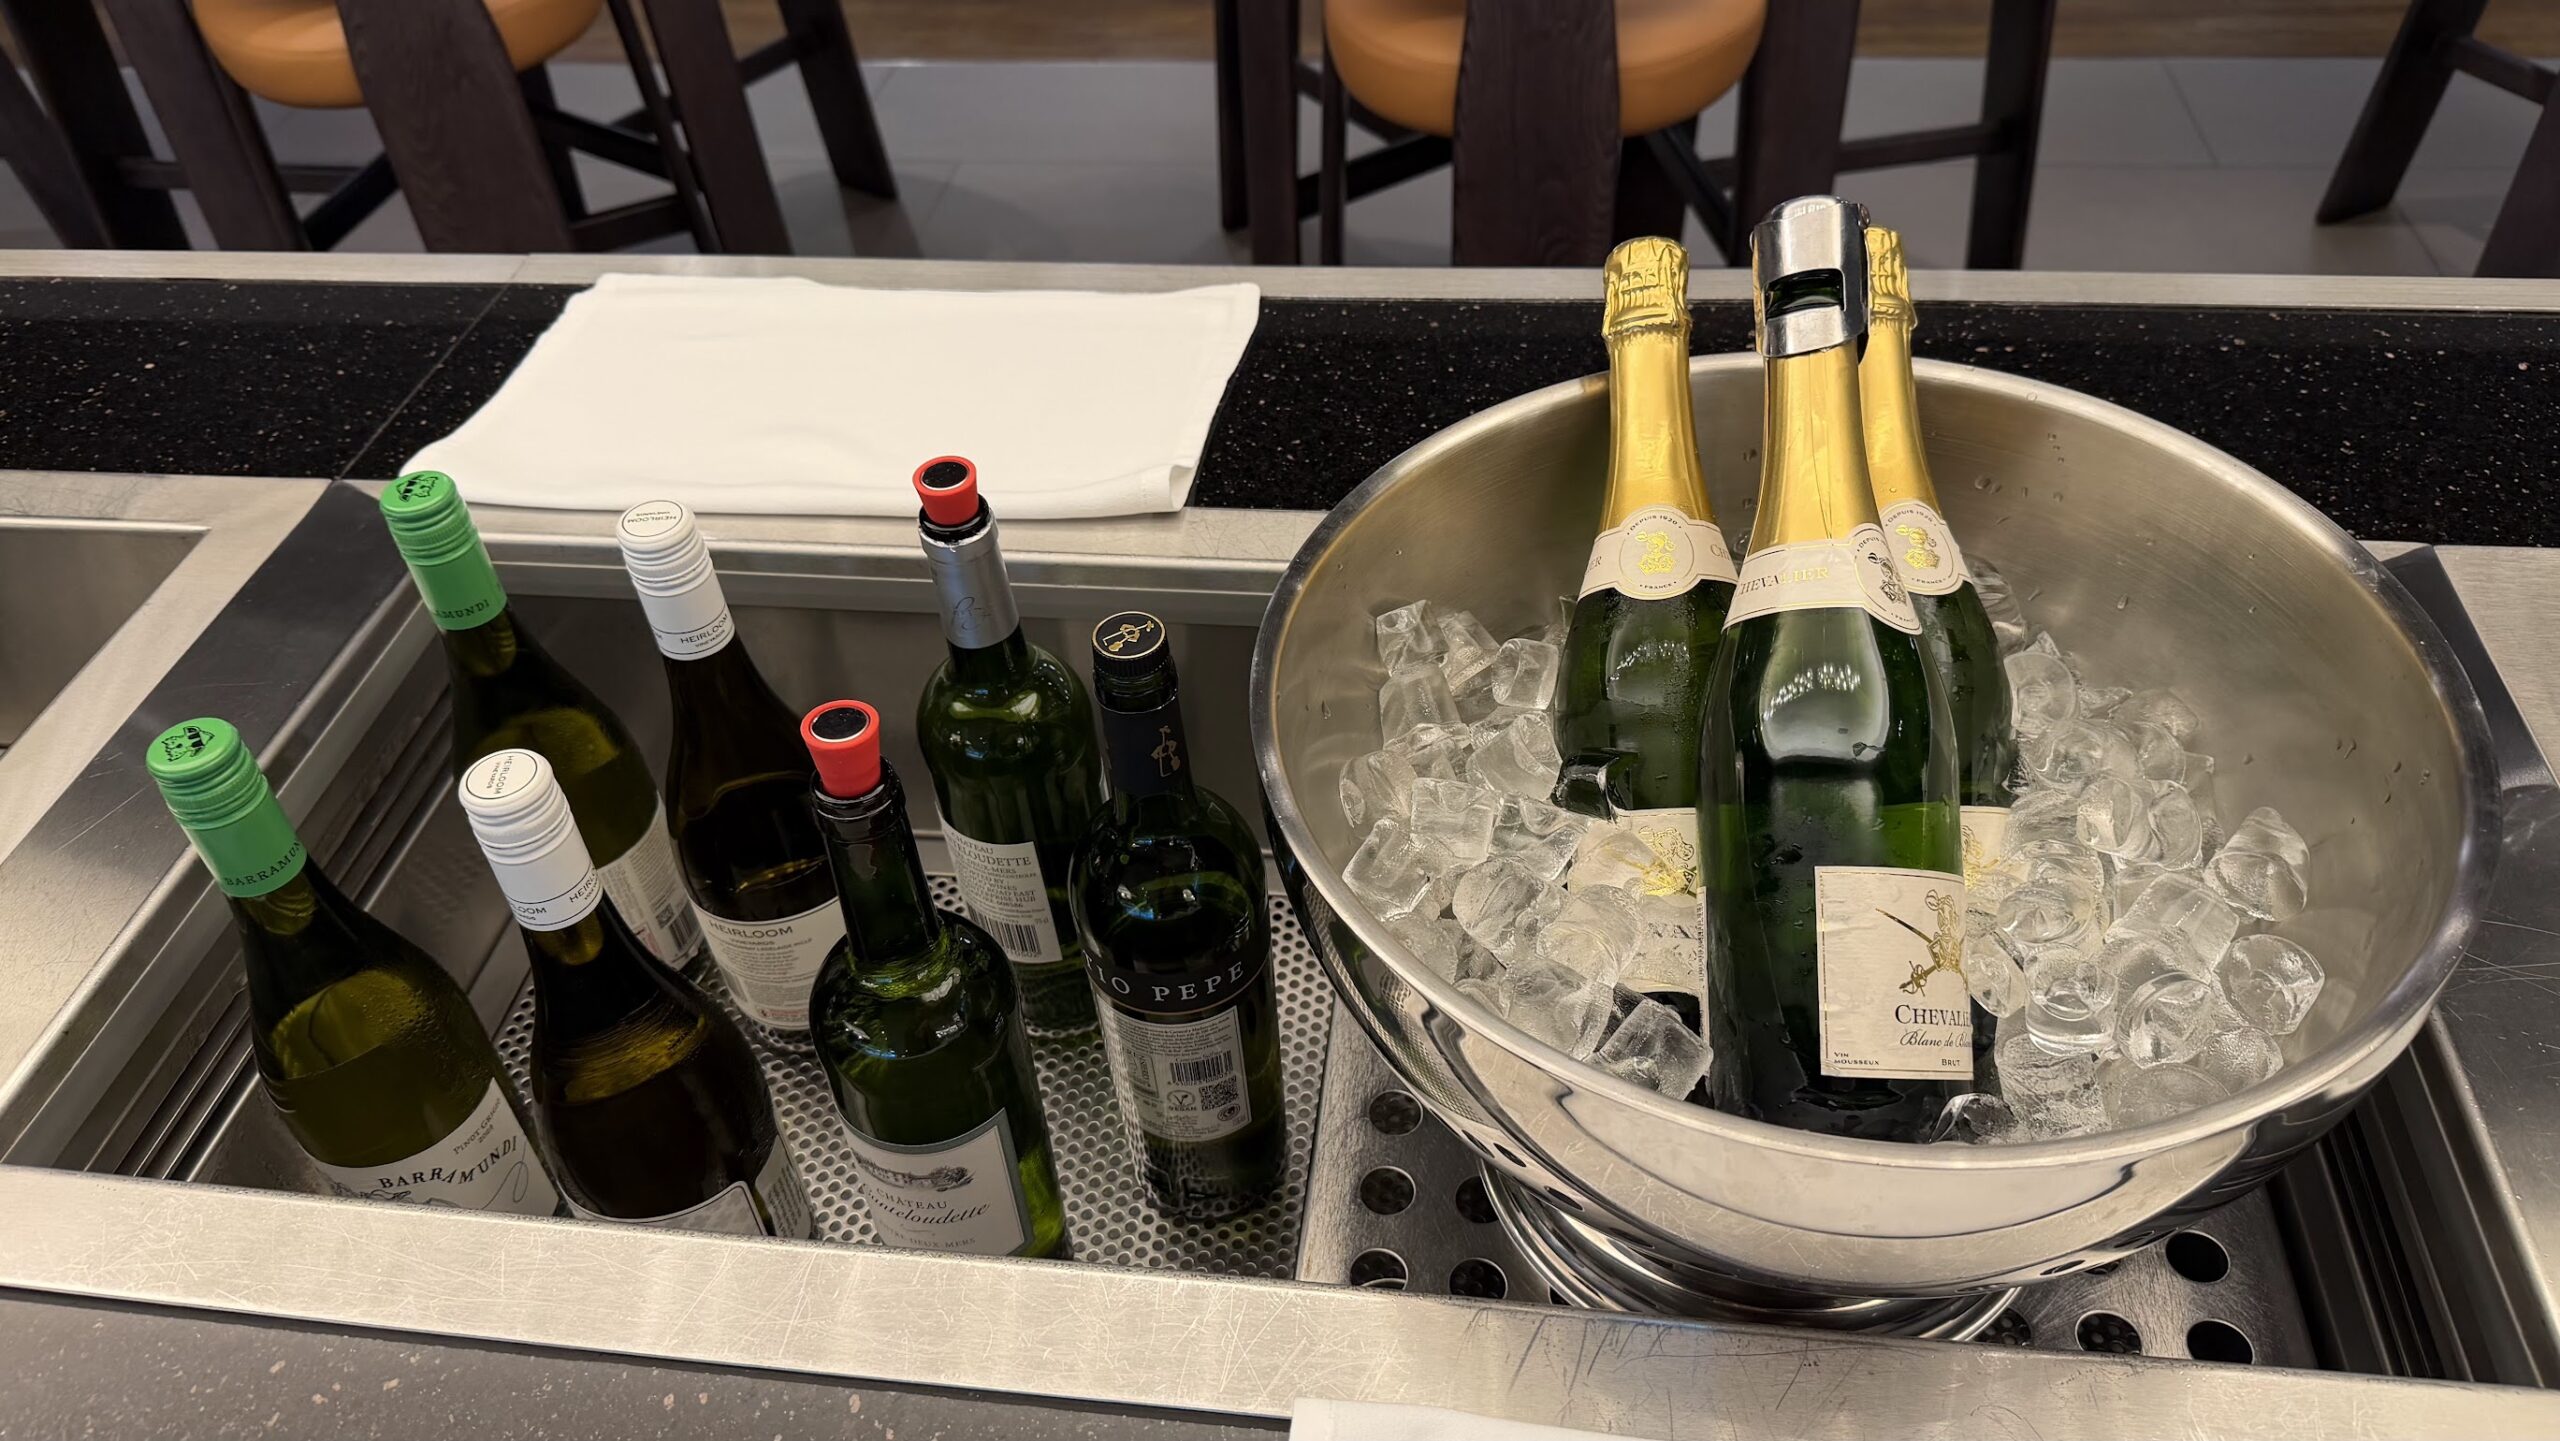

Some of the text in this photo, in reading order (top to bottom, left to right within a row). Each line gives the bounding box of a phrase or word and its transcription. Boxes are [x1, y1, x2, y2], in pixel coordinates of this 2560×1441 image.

[627, 514, 677, 524] HEIRLOOM
[1629, 514, 1678, 532] DEPUIS 1920
[1888, 509, 1914, 524] DEPUIS
[1643, 582, 1673, 590] FRANCE
[680, 612, 728, 644] HEIRLOOM
[494, 754, 515, 795] HEIRLOOM
[709, 920, 794, 939] HEIRLOOM
[1083, 949, 1244, 1002] TIO PEPE
[1899, 1029, 1942, 1046] Blanc
[1943, 1032, 1954, 1047] de
[1941, 1058, 1961, 1067] BRUT
[452, 1128, 482, 1155] PINOT
[377, 1135, 518, 1189] BARRAMUNDI
[944, 1237, 976, 1249] MERS
